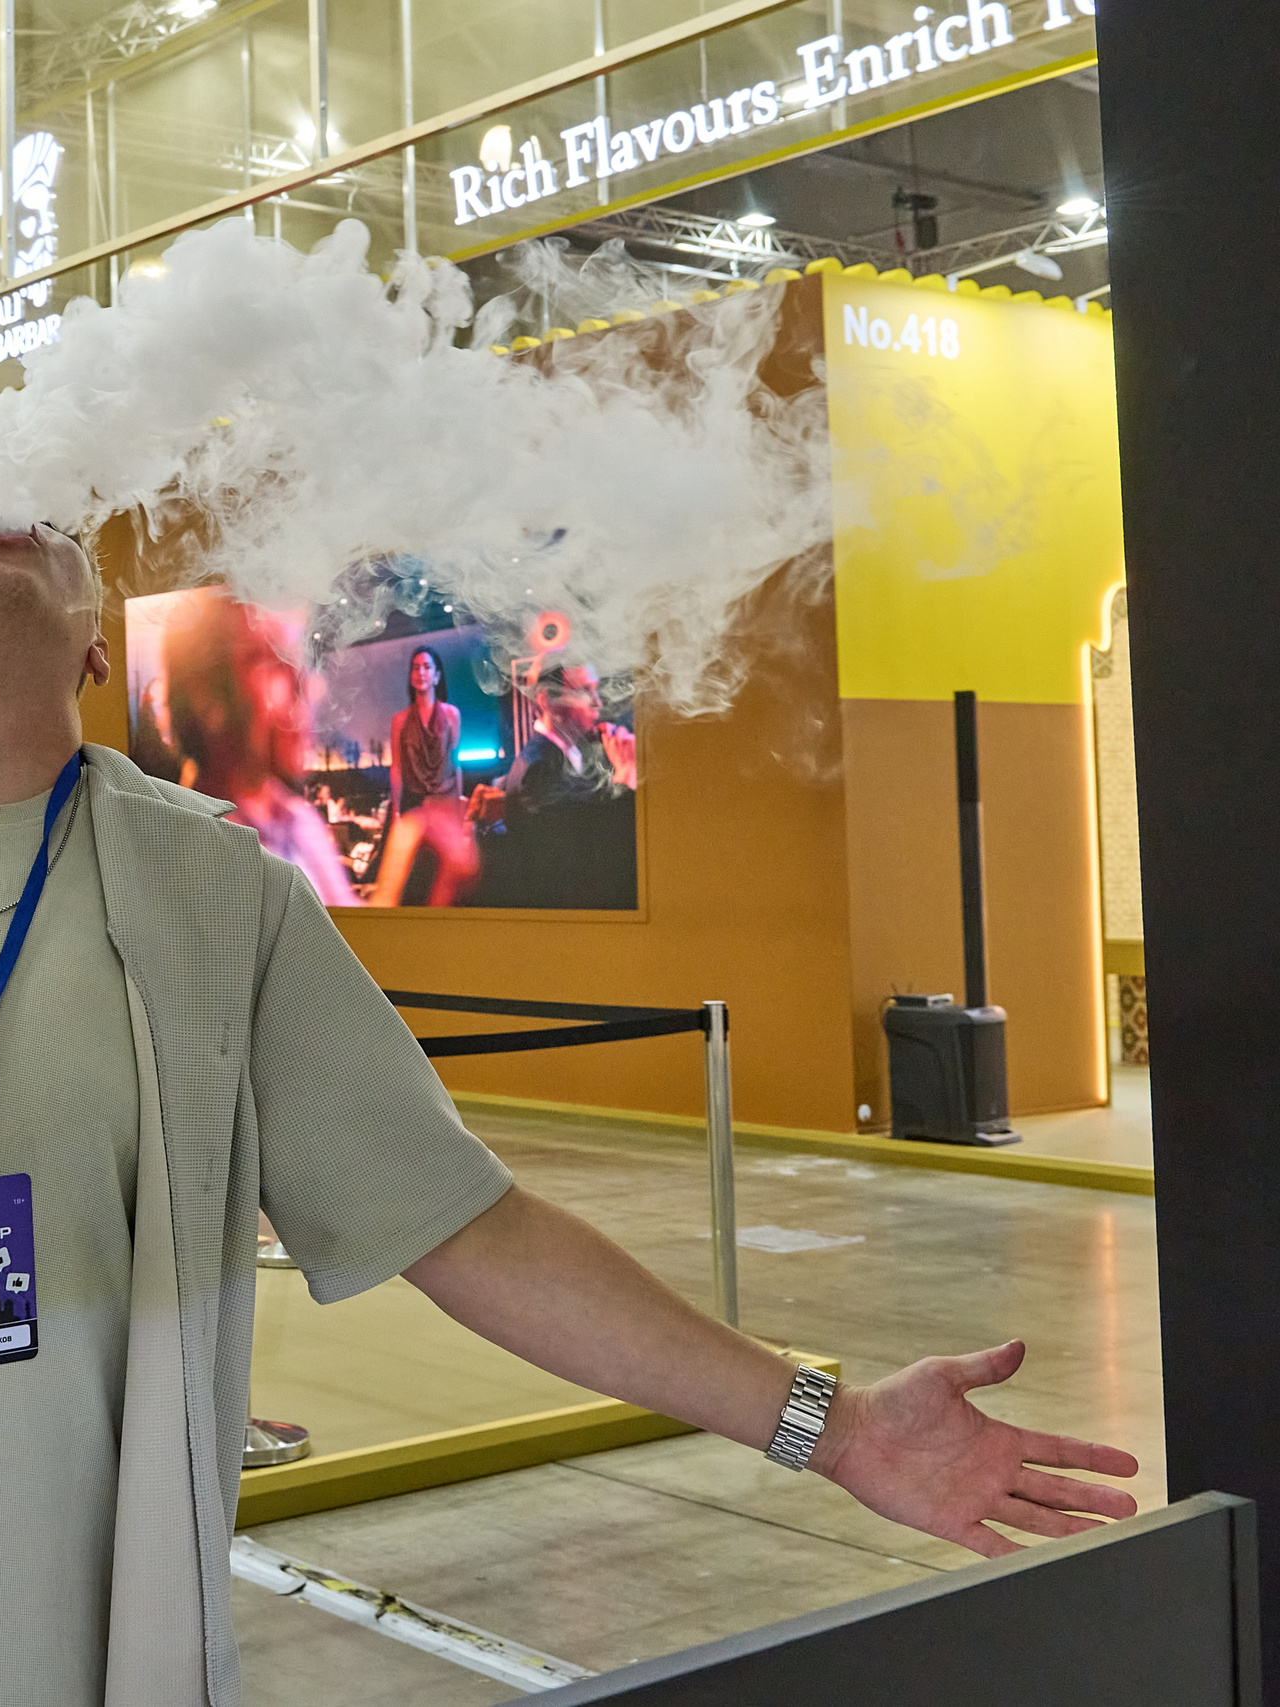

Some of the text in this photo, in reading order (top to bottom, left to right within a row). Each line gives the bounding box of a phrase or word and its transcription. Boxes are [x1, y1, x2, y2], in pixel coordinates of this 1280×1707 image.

[449, 0, 1014, 226] Rich Flavours Enrich
[843, 303, 960, 360] No.418
